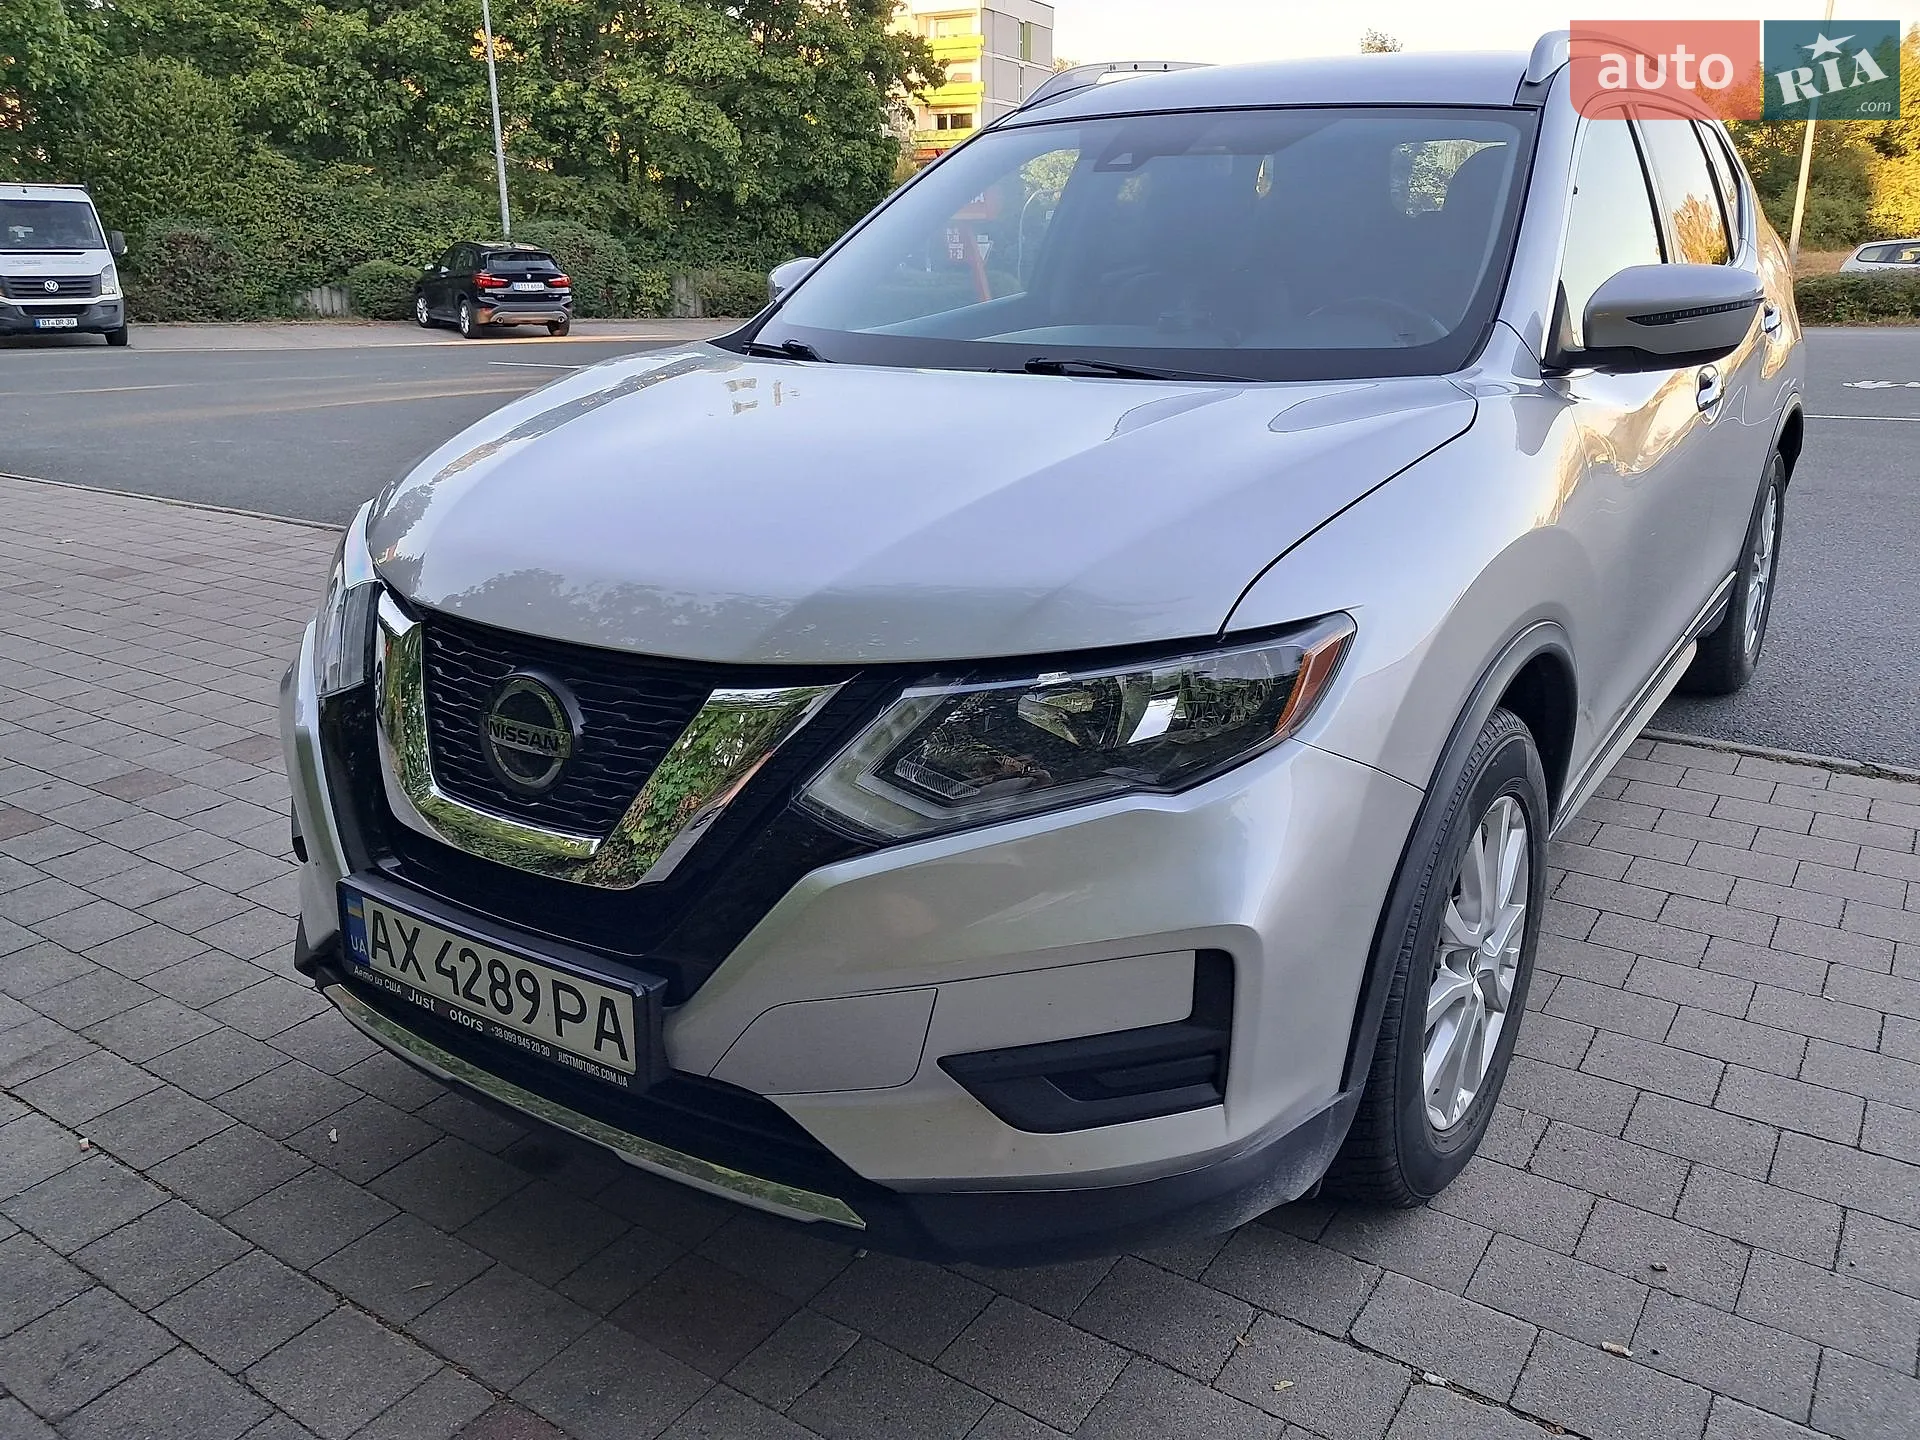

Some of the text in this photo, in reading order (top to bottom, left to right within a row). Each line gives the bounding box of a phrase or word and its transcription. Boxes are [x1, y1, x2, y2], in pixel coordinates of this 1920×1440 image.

[489, 720, 559, 751] NISSAN
[351, 935, 367, 955] UA
[371, 909, 629, 1062] AX 4289 PA
[384, 979, 402, 995] США
[408, 989, 484, 1032] Just otors
[558, 1051, 629, 1088] JUSTMOTORS.COM.UA
